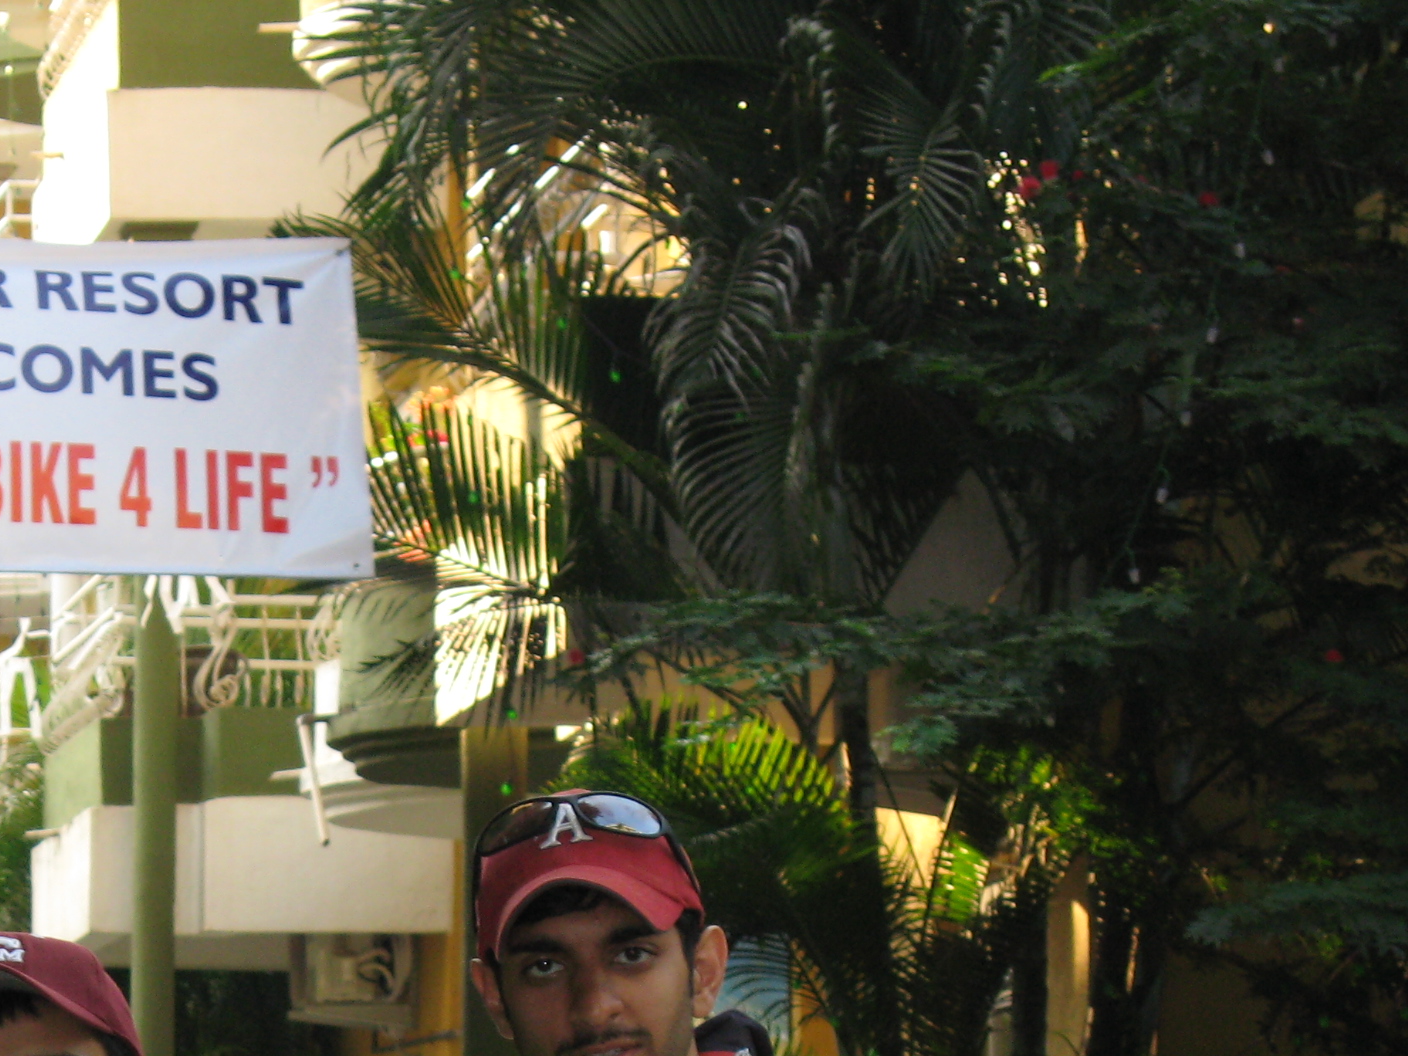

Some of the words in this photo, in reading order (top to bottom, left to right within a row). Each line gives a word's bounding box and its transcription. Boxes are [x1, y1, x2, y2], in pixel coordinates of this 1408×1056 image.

[35, 269, 303, 325] RESORT
[120, 446, 152, 528] 4
[175, 447, 290, 533] LIFE
[540, 803, 593, 850] A
